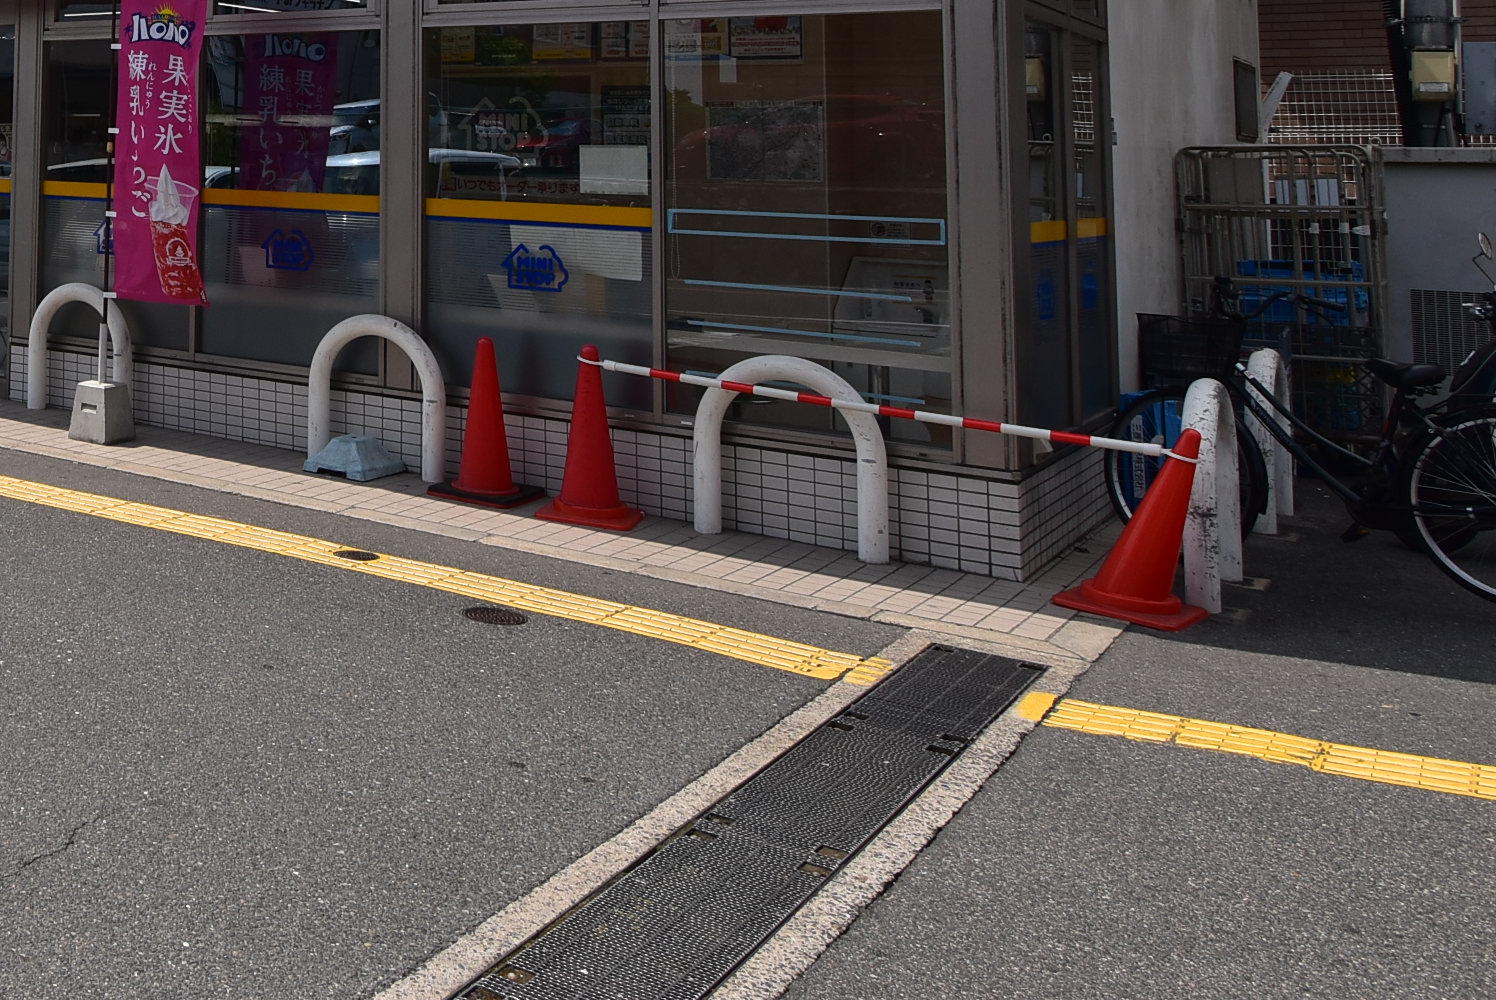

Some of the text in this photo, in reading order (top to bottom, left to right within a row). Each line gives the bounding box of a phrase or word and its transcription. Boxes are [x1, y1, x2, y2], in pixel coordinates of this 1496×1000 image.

[154, 54, 188, 155] 果実氷
[258, 63, 286, 190] 練乳いち
[516, 271, 556, 286] STOP
[517, 255, 553, 271] MINI
